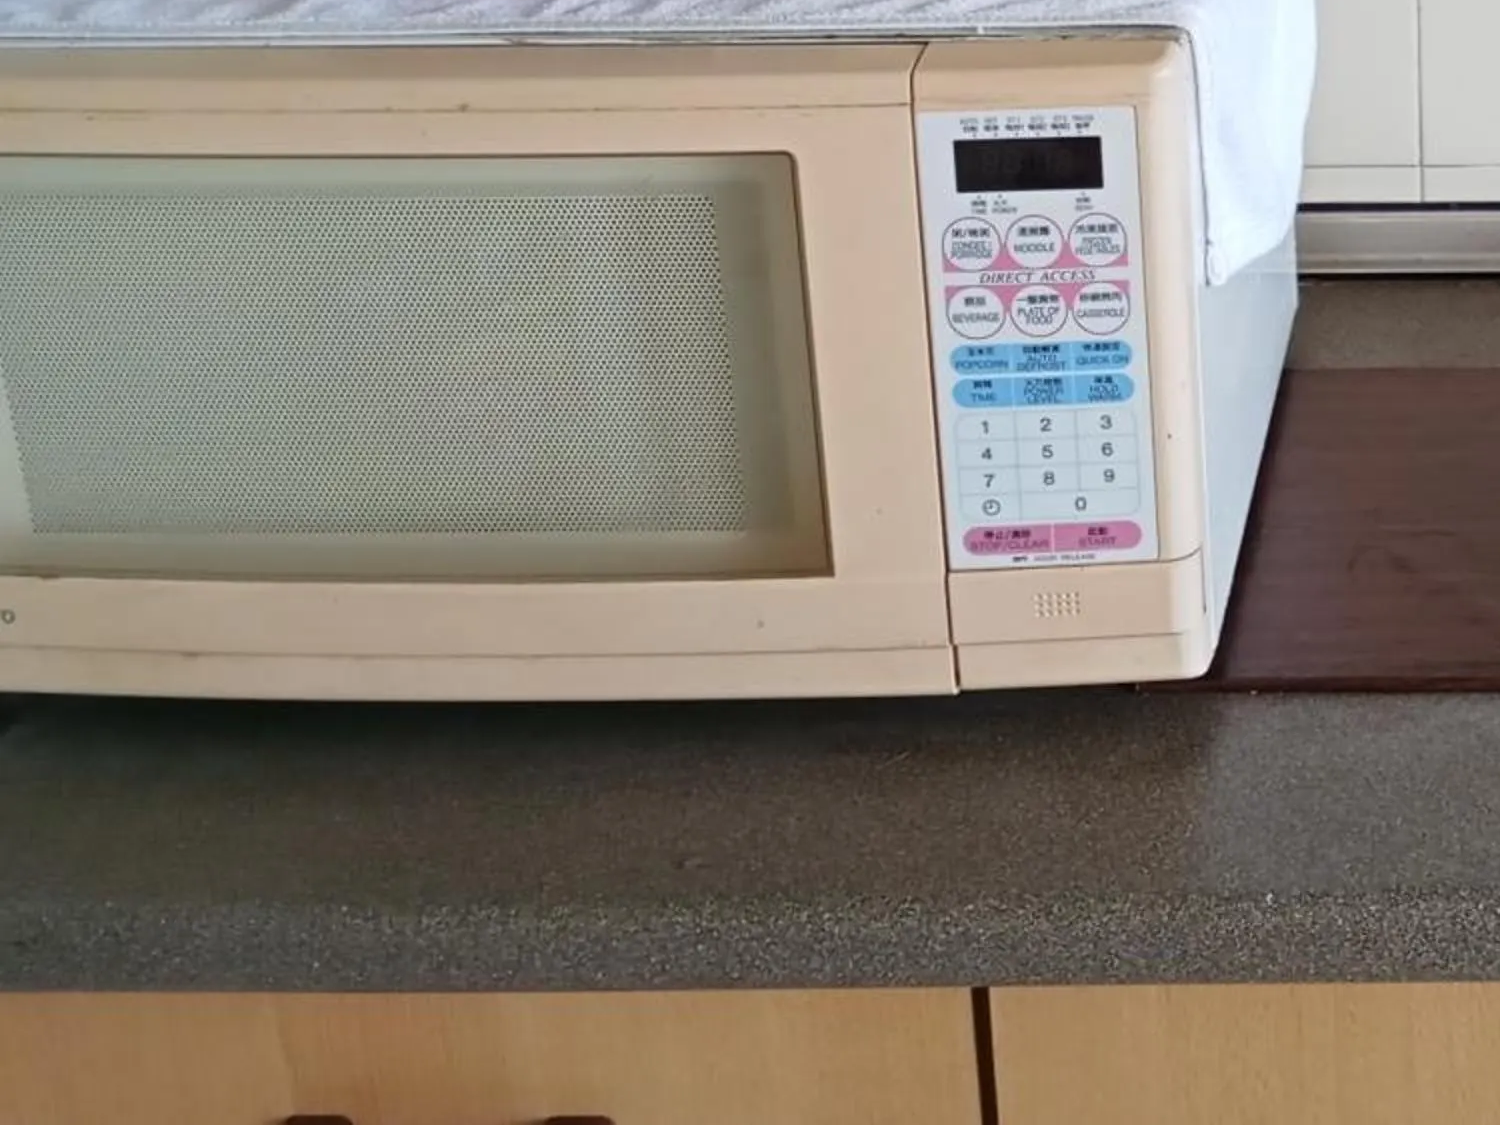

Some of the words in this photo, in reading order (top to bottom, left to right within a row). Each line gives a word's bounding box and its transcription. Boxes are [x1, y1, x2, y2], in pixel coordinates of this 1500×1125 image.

[1014, 242, 1055, 252] NOODLE
[979, 272, 1032, 284] DIRECT
[1040, 269, 1095, 282] ACCESS
[952, 312, 999, 323] BEVERAGE
[955, 360, 1008, 370] POPCORN
[1076, 356, 1110, 366] QUICK
[1112, 354, 1129, 364] ON
[981, 420, 989, 434] 1
[1040, 418, 1052, 432] 2
[1100, 415, 1112, 430] 3
[981, 447, 993, 461] 4
[1041, 444, 1053, 459] 5
[1101, 442, 1114, 457] 6
[983, 473, 995, 488] 7
[1043, 471, 1055, 486] 8
[1103, 468, 1115, 483] 9
[1075, 496, 1087, 511] 0
